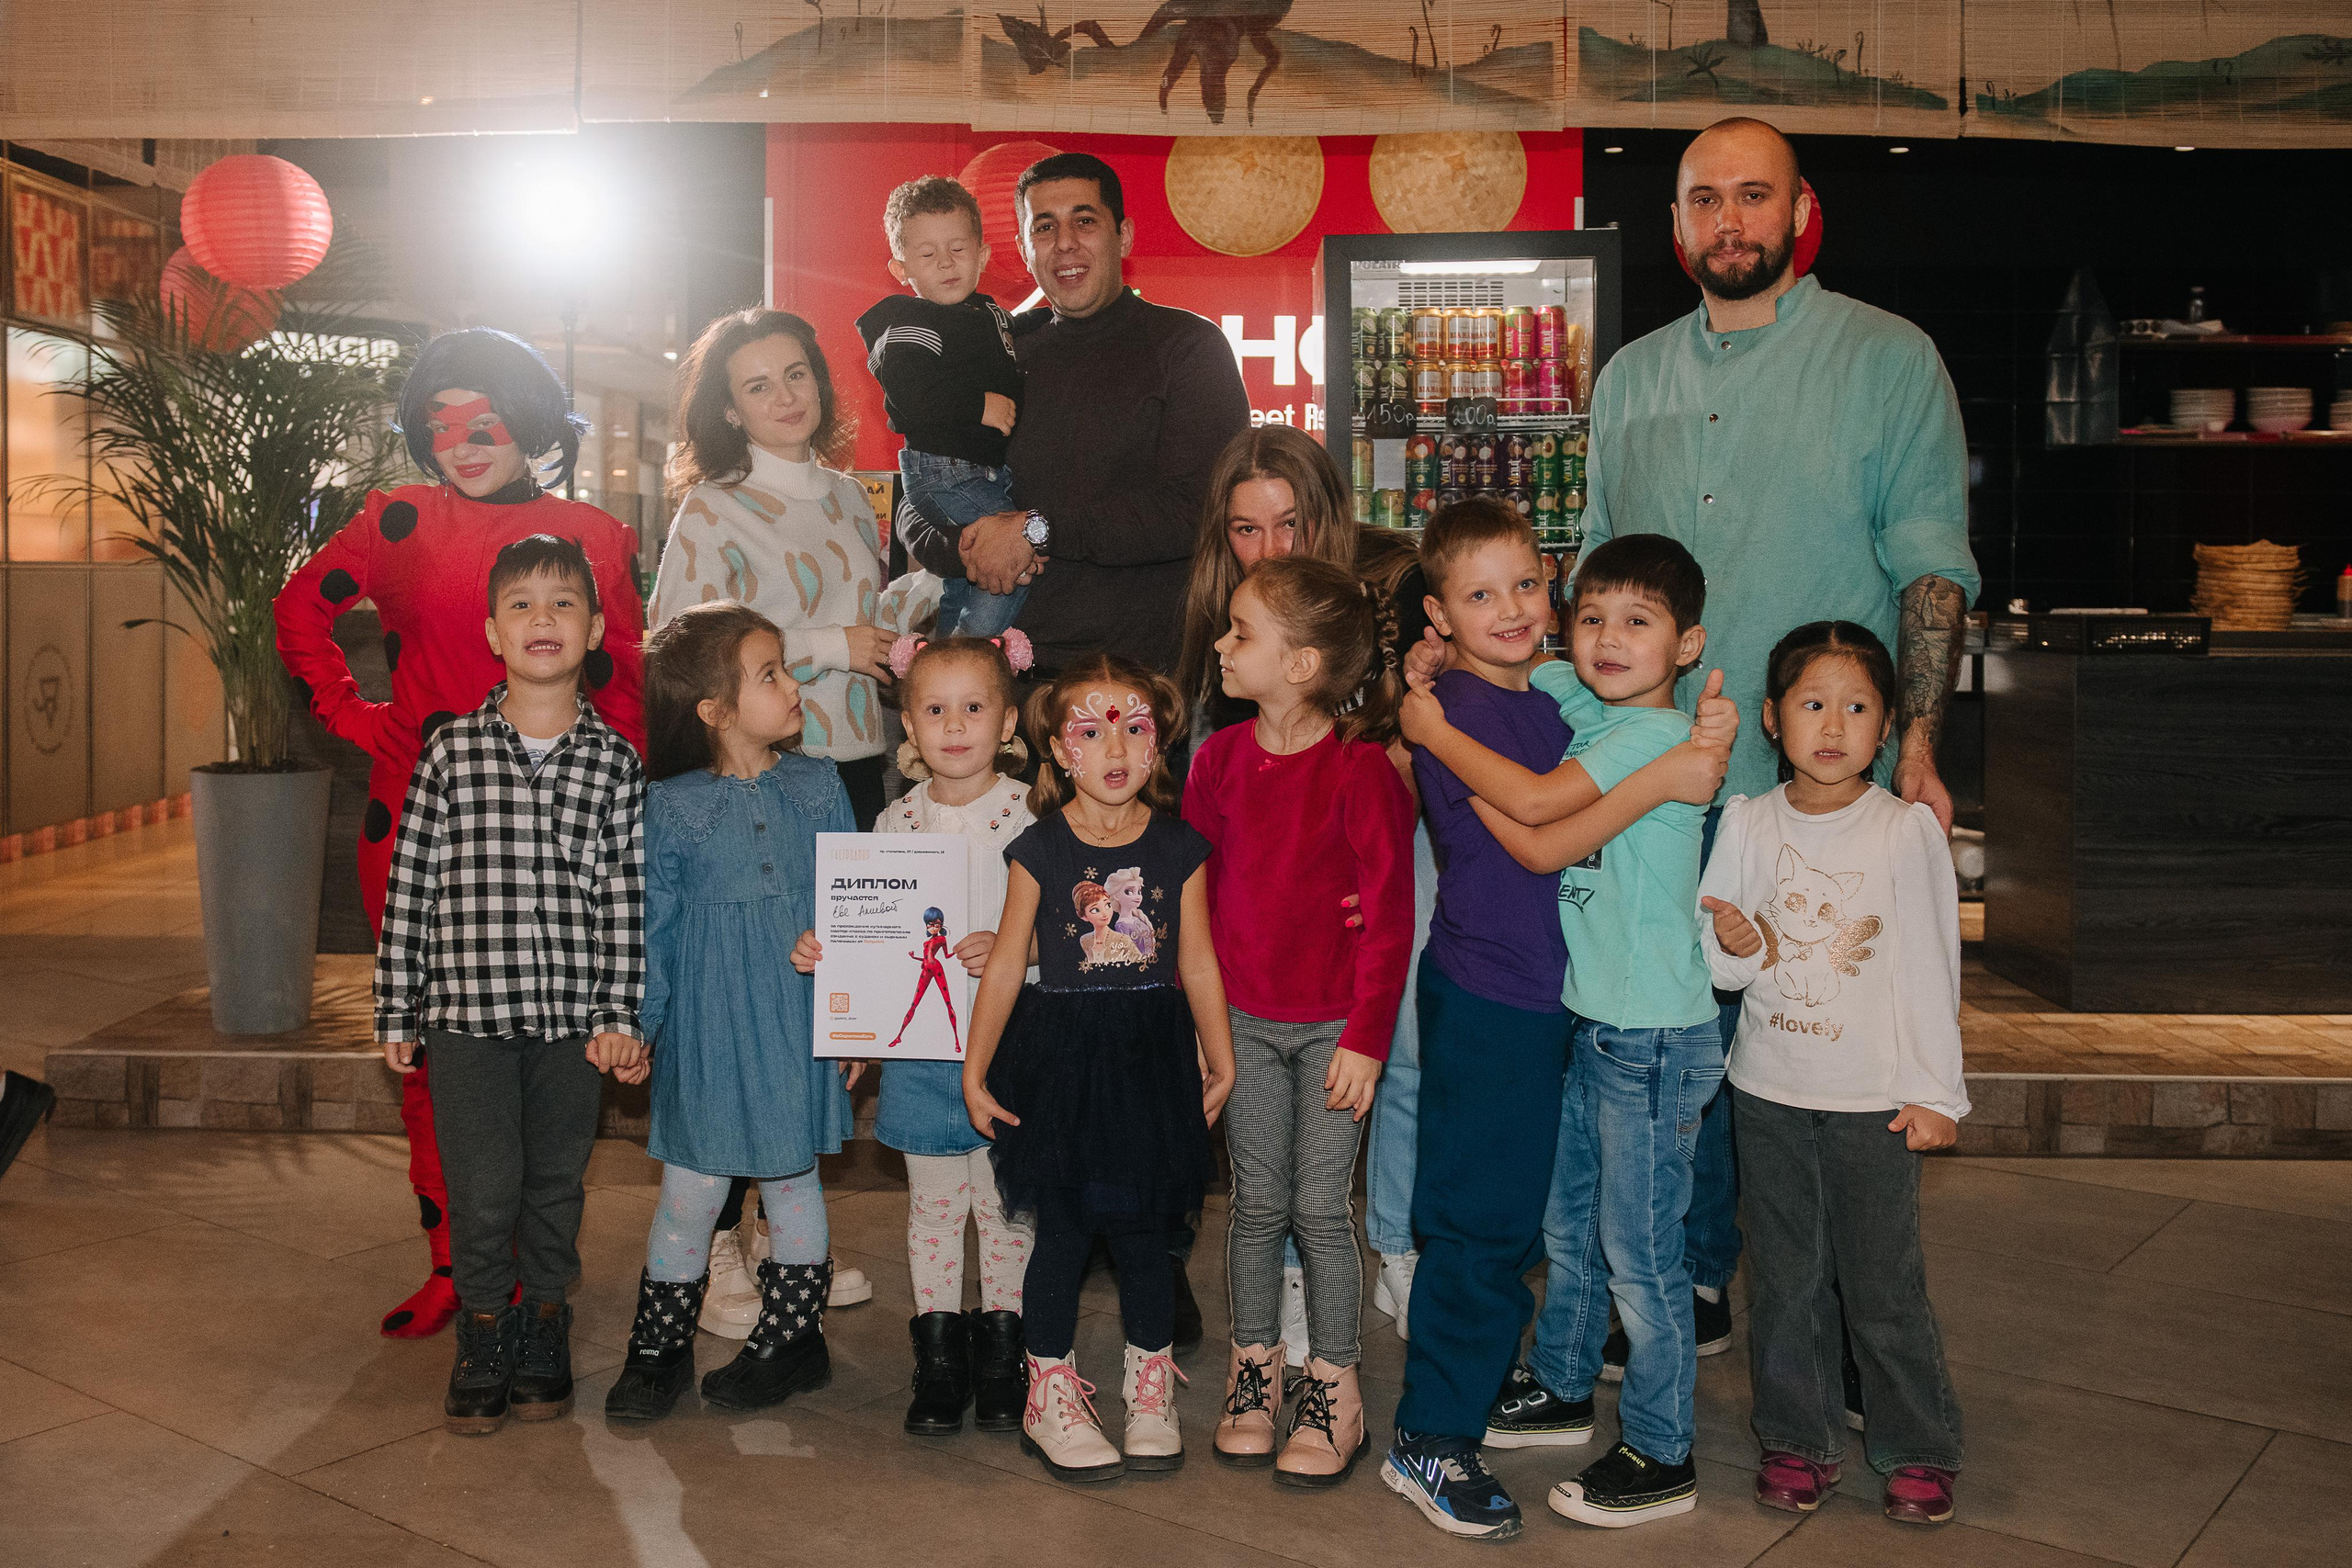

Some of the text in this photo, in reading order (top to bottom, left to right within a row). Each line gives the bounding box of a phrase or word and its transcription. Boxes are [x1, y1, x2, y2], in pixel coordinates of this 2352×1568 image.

[1441, 459, 1452, 485] Vinut
[1508, 458, 1521, 485] Vinut
[831, 877, 918, 891] ДИПЛОМ
[1769, 1011, 1845, 1043] #lovely
[639, 1348, 660, 1357] reima
